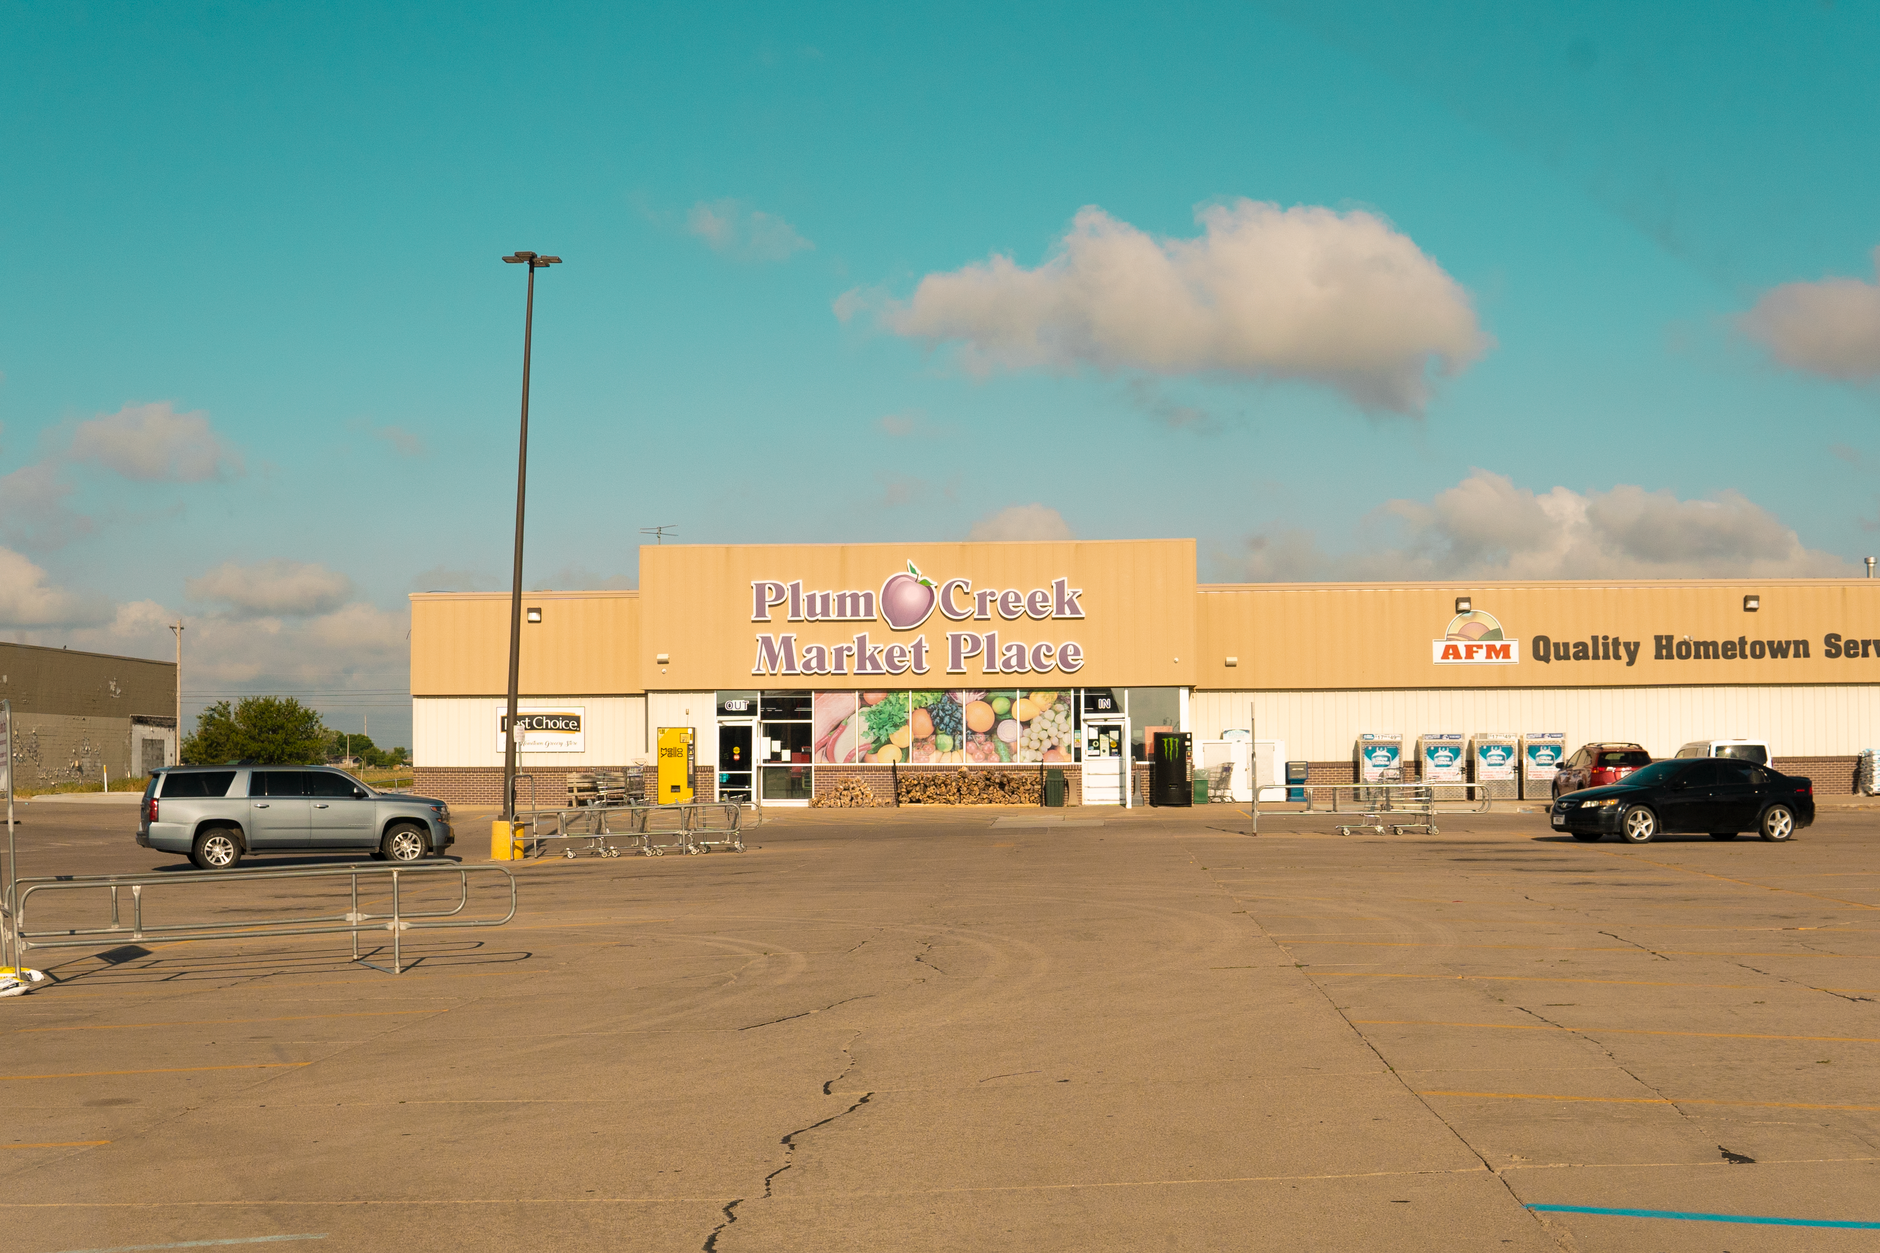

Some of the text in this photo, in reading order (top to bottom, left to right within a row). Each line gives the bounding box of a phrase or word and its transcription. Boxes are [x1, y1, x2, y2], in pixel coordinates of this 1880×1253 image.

[751, 577, 1085, 620] Plum Creek
[752, 631, 1084, 675] Market Place
[1441, 644, 1511, 660] AFM
[1532, 635, 1640, 667] Quality
[1654, 634, 1810, 660] Hometown
[724, 700, 749, 711] OUT
[1098, 698, 1111, 709] IN
